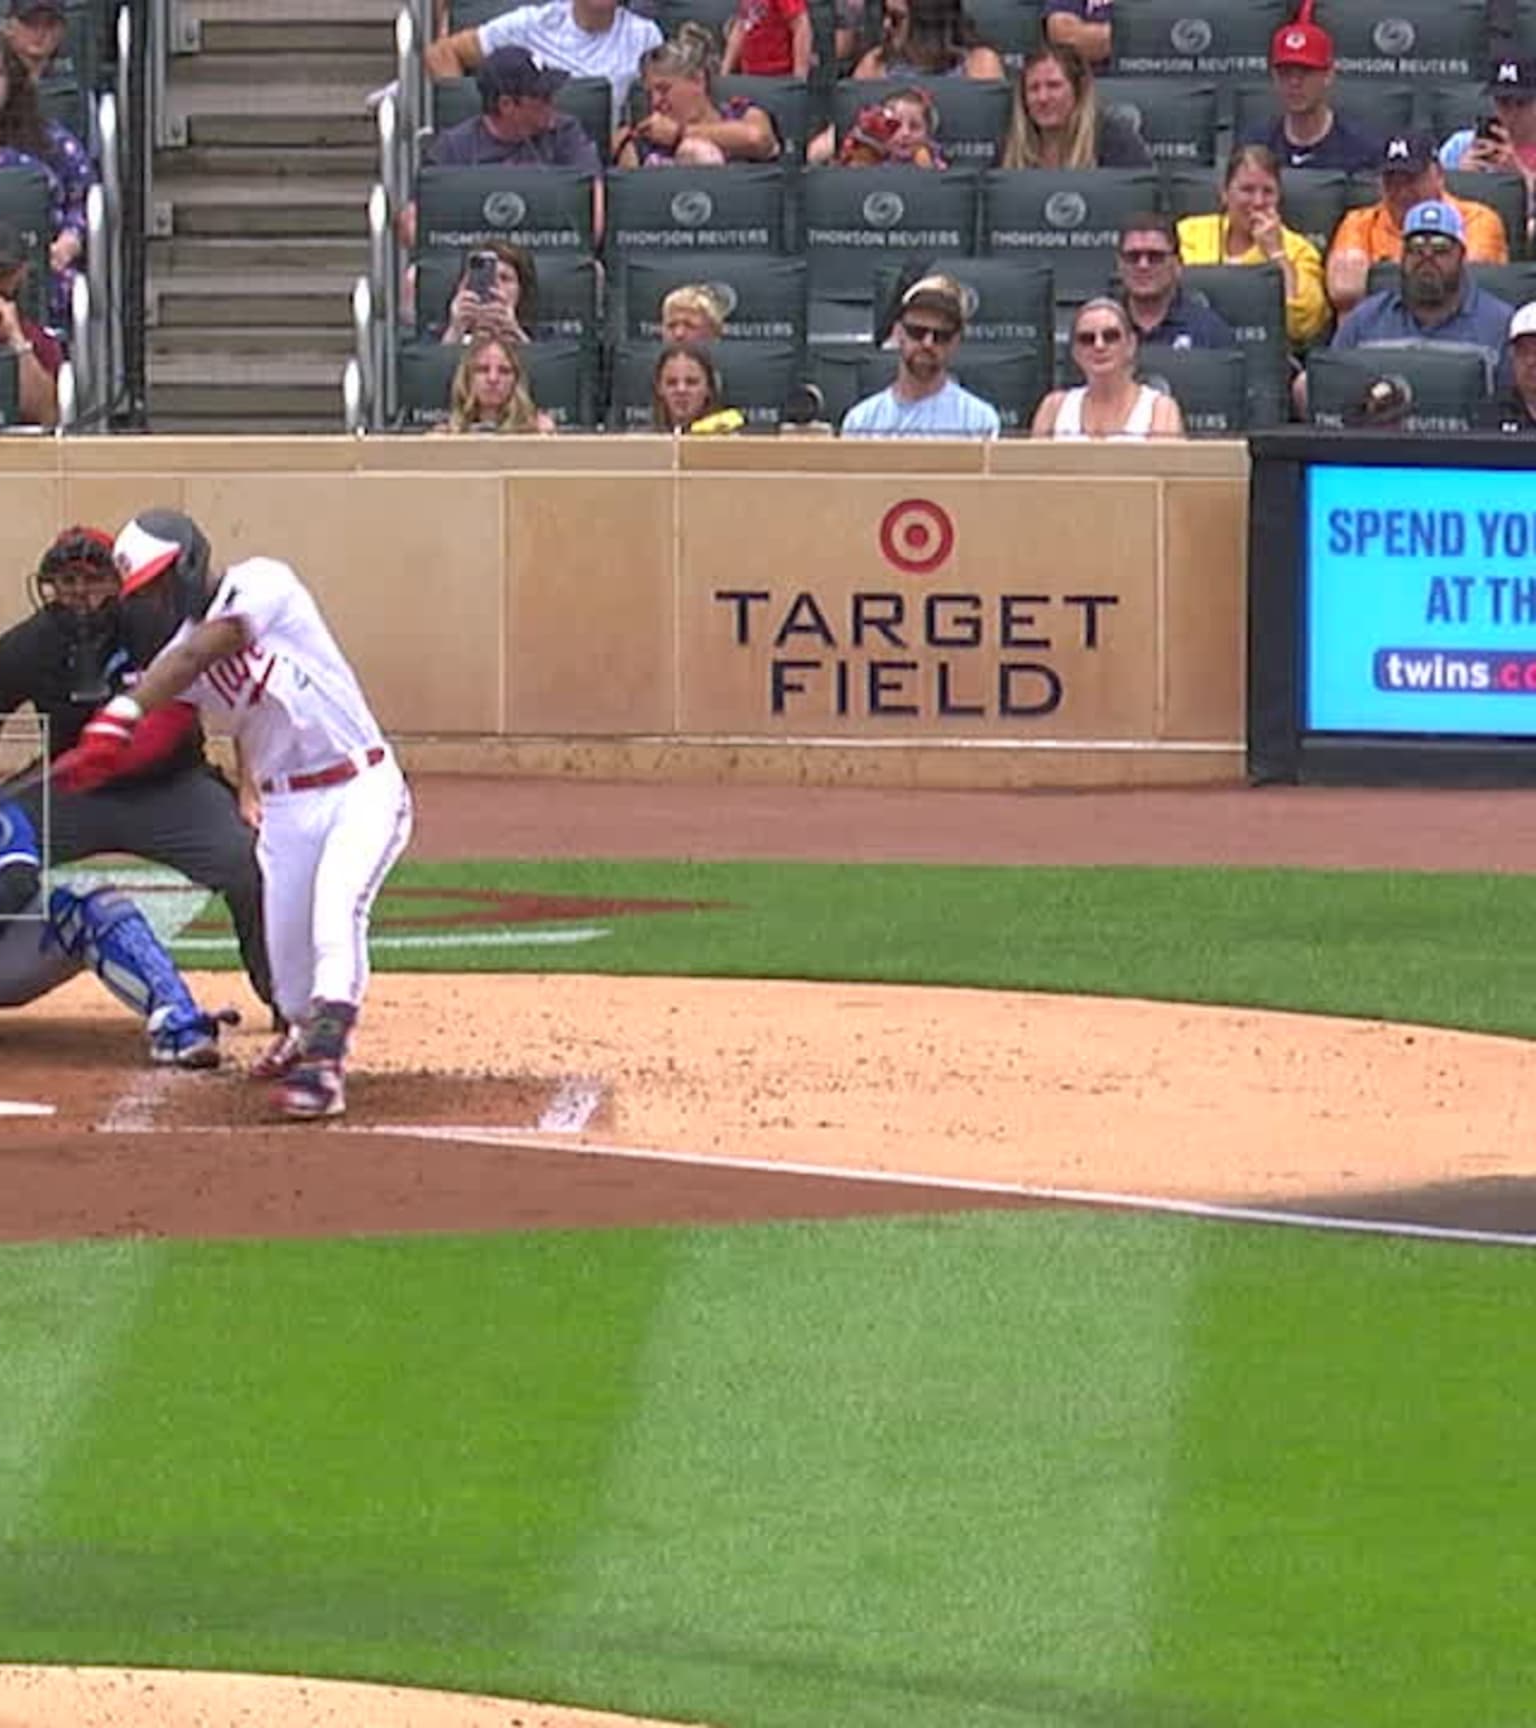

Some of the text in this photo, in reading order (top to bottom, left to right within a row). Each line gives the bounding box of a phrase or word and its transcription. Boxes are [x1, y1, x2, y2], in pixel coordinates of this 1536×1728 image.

[1119, 58, 1267, 73] THOMSON REUTERS
[1399, 59, 1469, 74] REUTERS
[1498, 64, 1519, 82] M
[1387, 140, 1410, 158] M
[510, 231, 580, 246] REUTERS
[617, 229, 769, 245] THOMSON REUTERS
[809, 230, 960, 246] THOMSON REUTERS
[991, 231, 1120, 246] THOMSON REUTE
[1328, 508, 1536, 558] SPEND YO
[1425, 575, 1476, 625] AT
[714, 590, 1120, 649] TARGET
[770, 659, 1064, 717] FIELD
